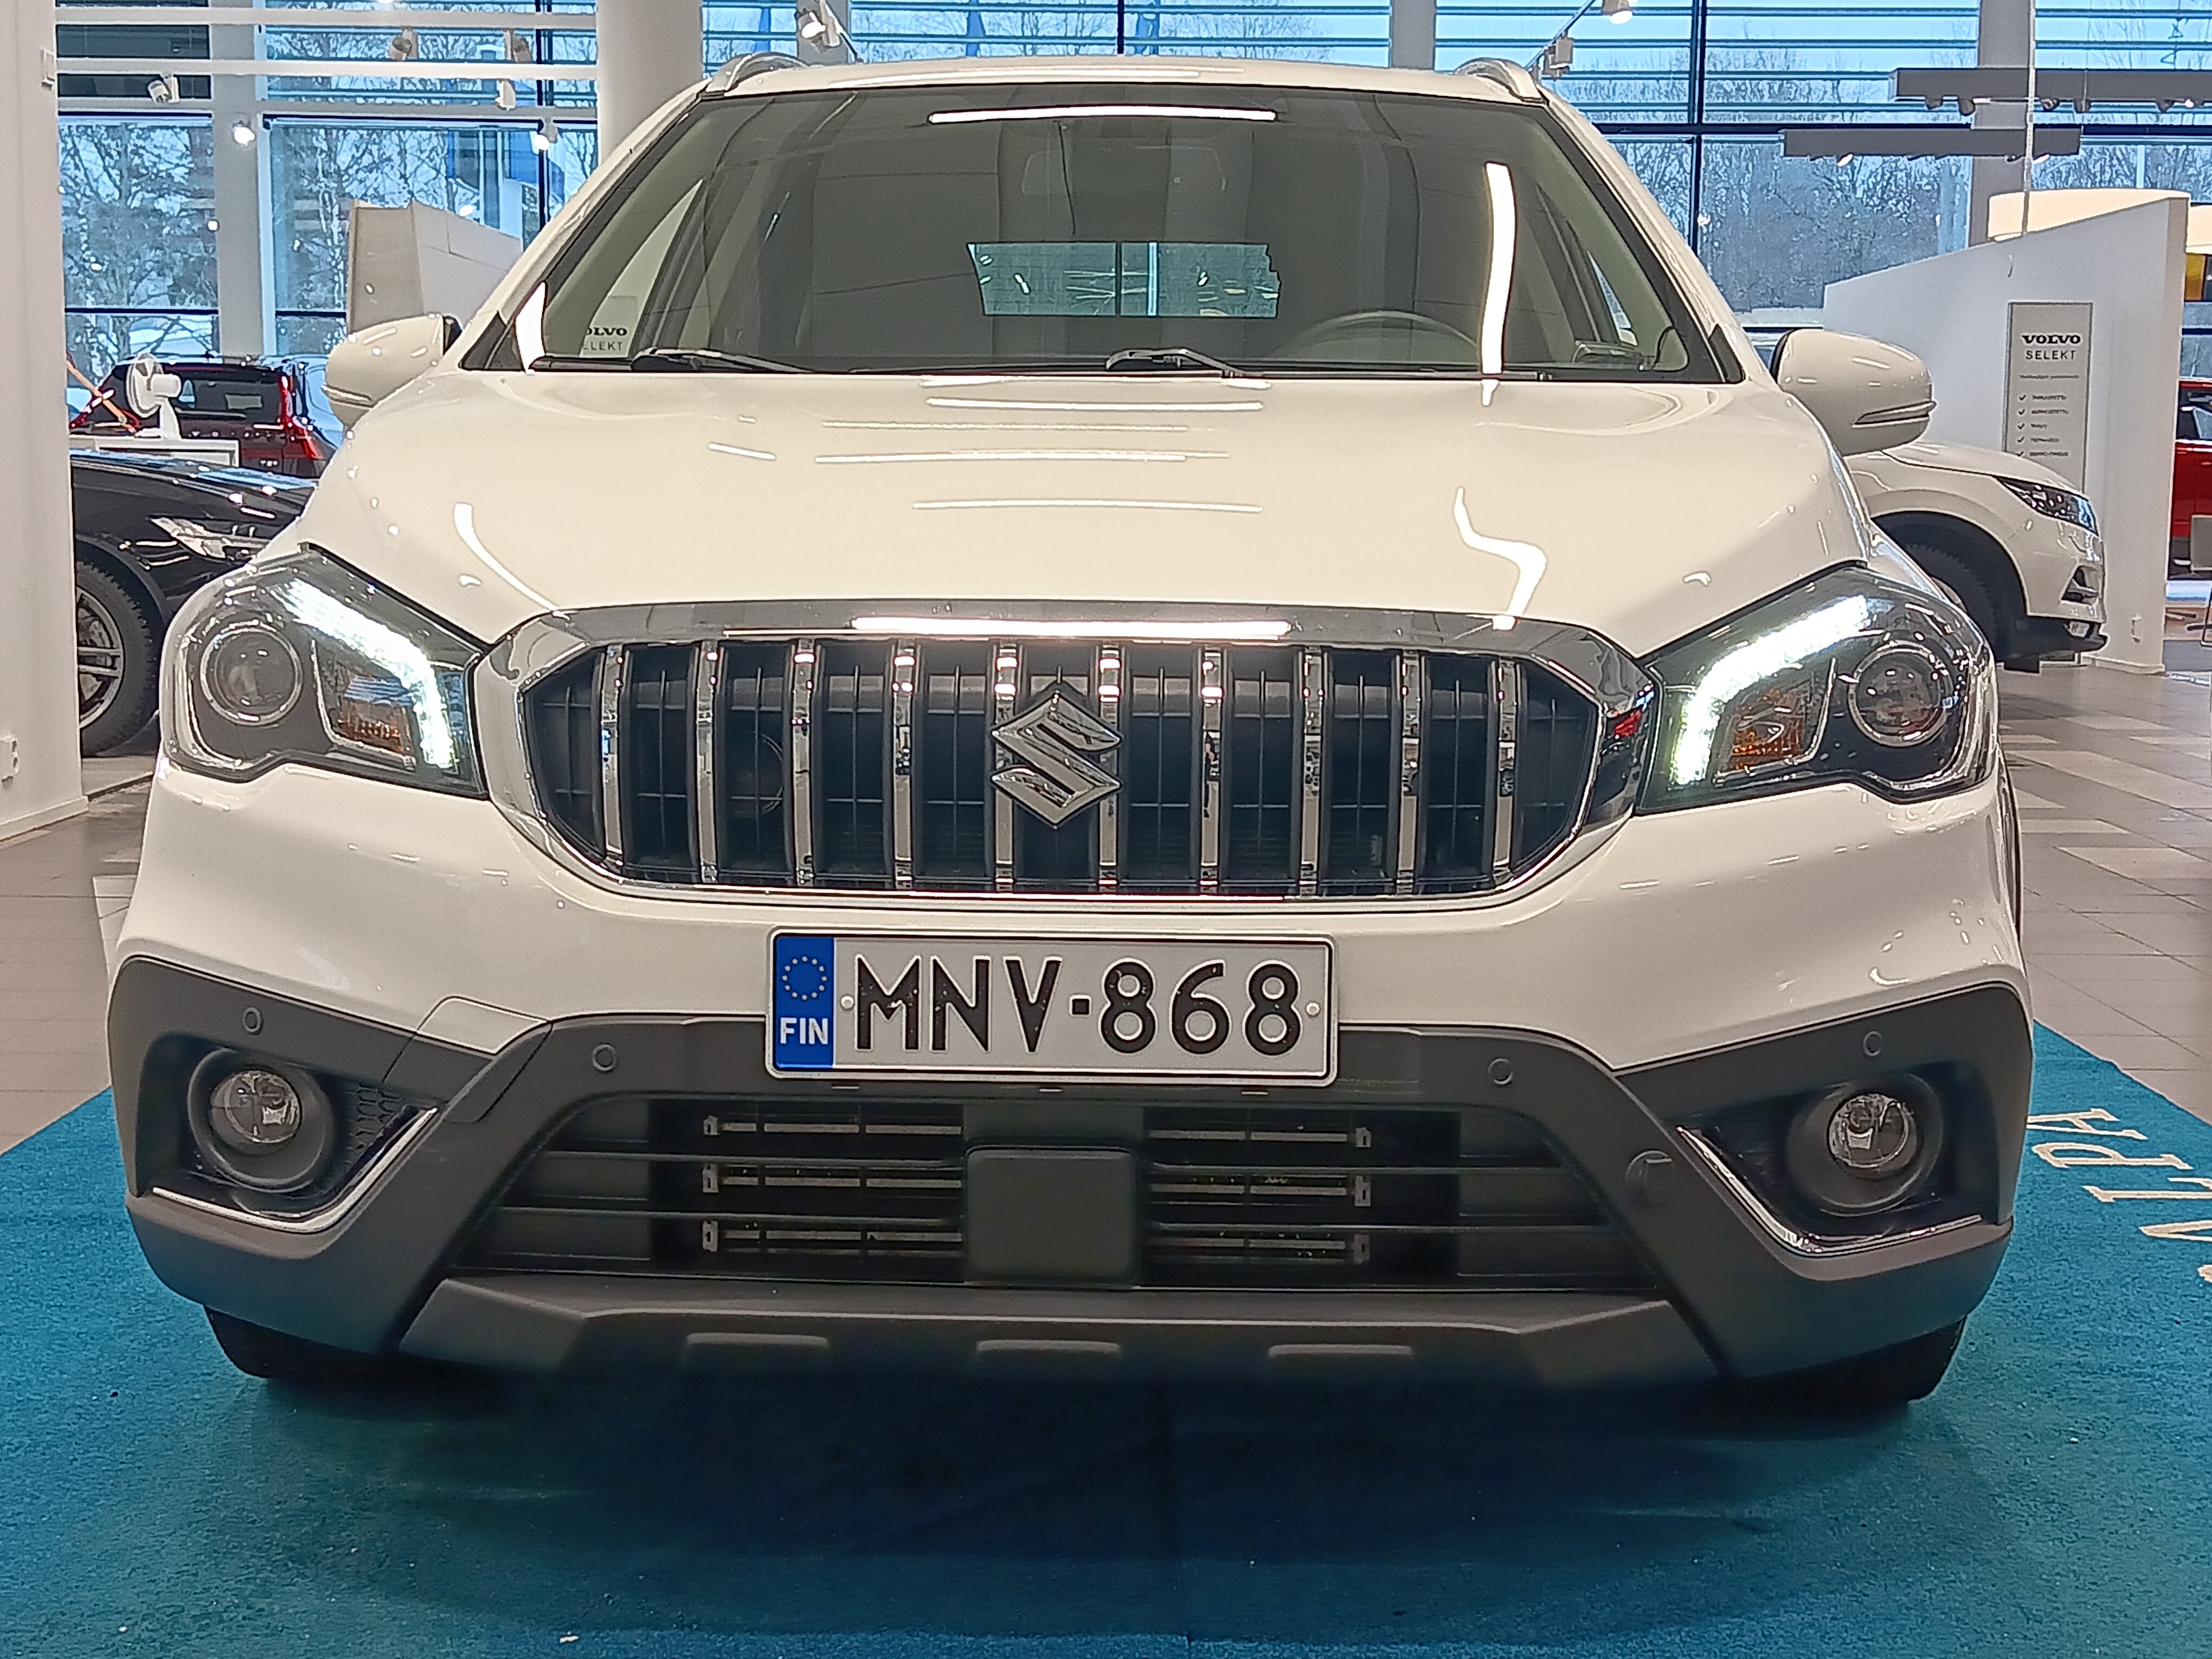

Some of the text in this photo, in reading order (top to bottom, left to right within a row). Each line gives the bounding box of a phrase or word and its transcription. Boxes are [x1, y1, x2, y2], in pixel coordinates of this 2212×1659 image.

[2021, 335, 2081, 344] VOLVO
[2025, 350, 2076, 360] SELEKT
[855, 955, 1302, 1056] MNV-868
[779, 1017, 828, 1045] FIN
